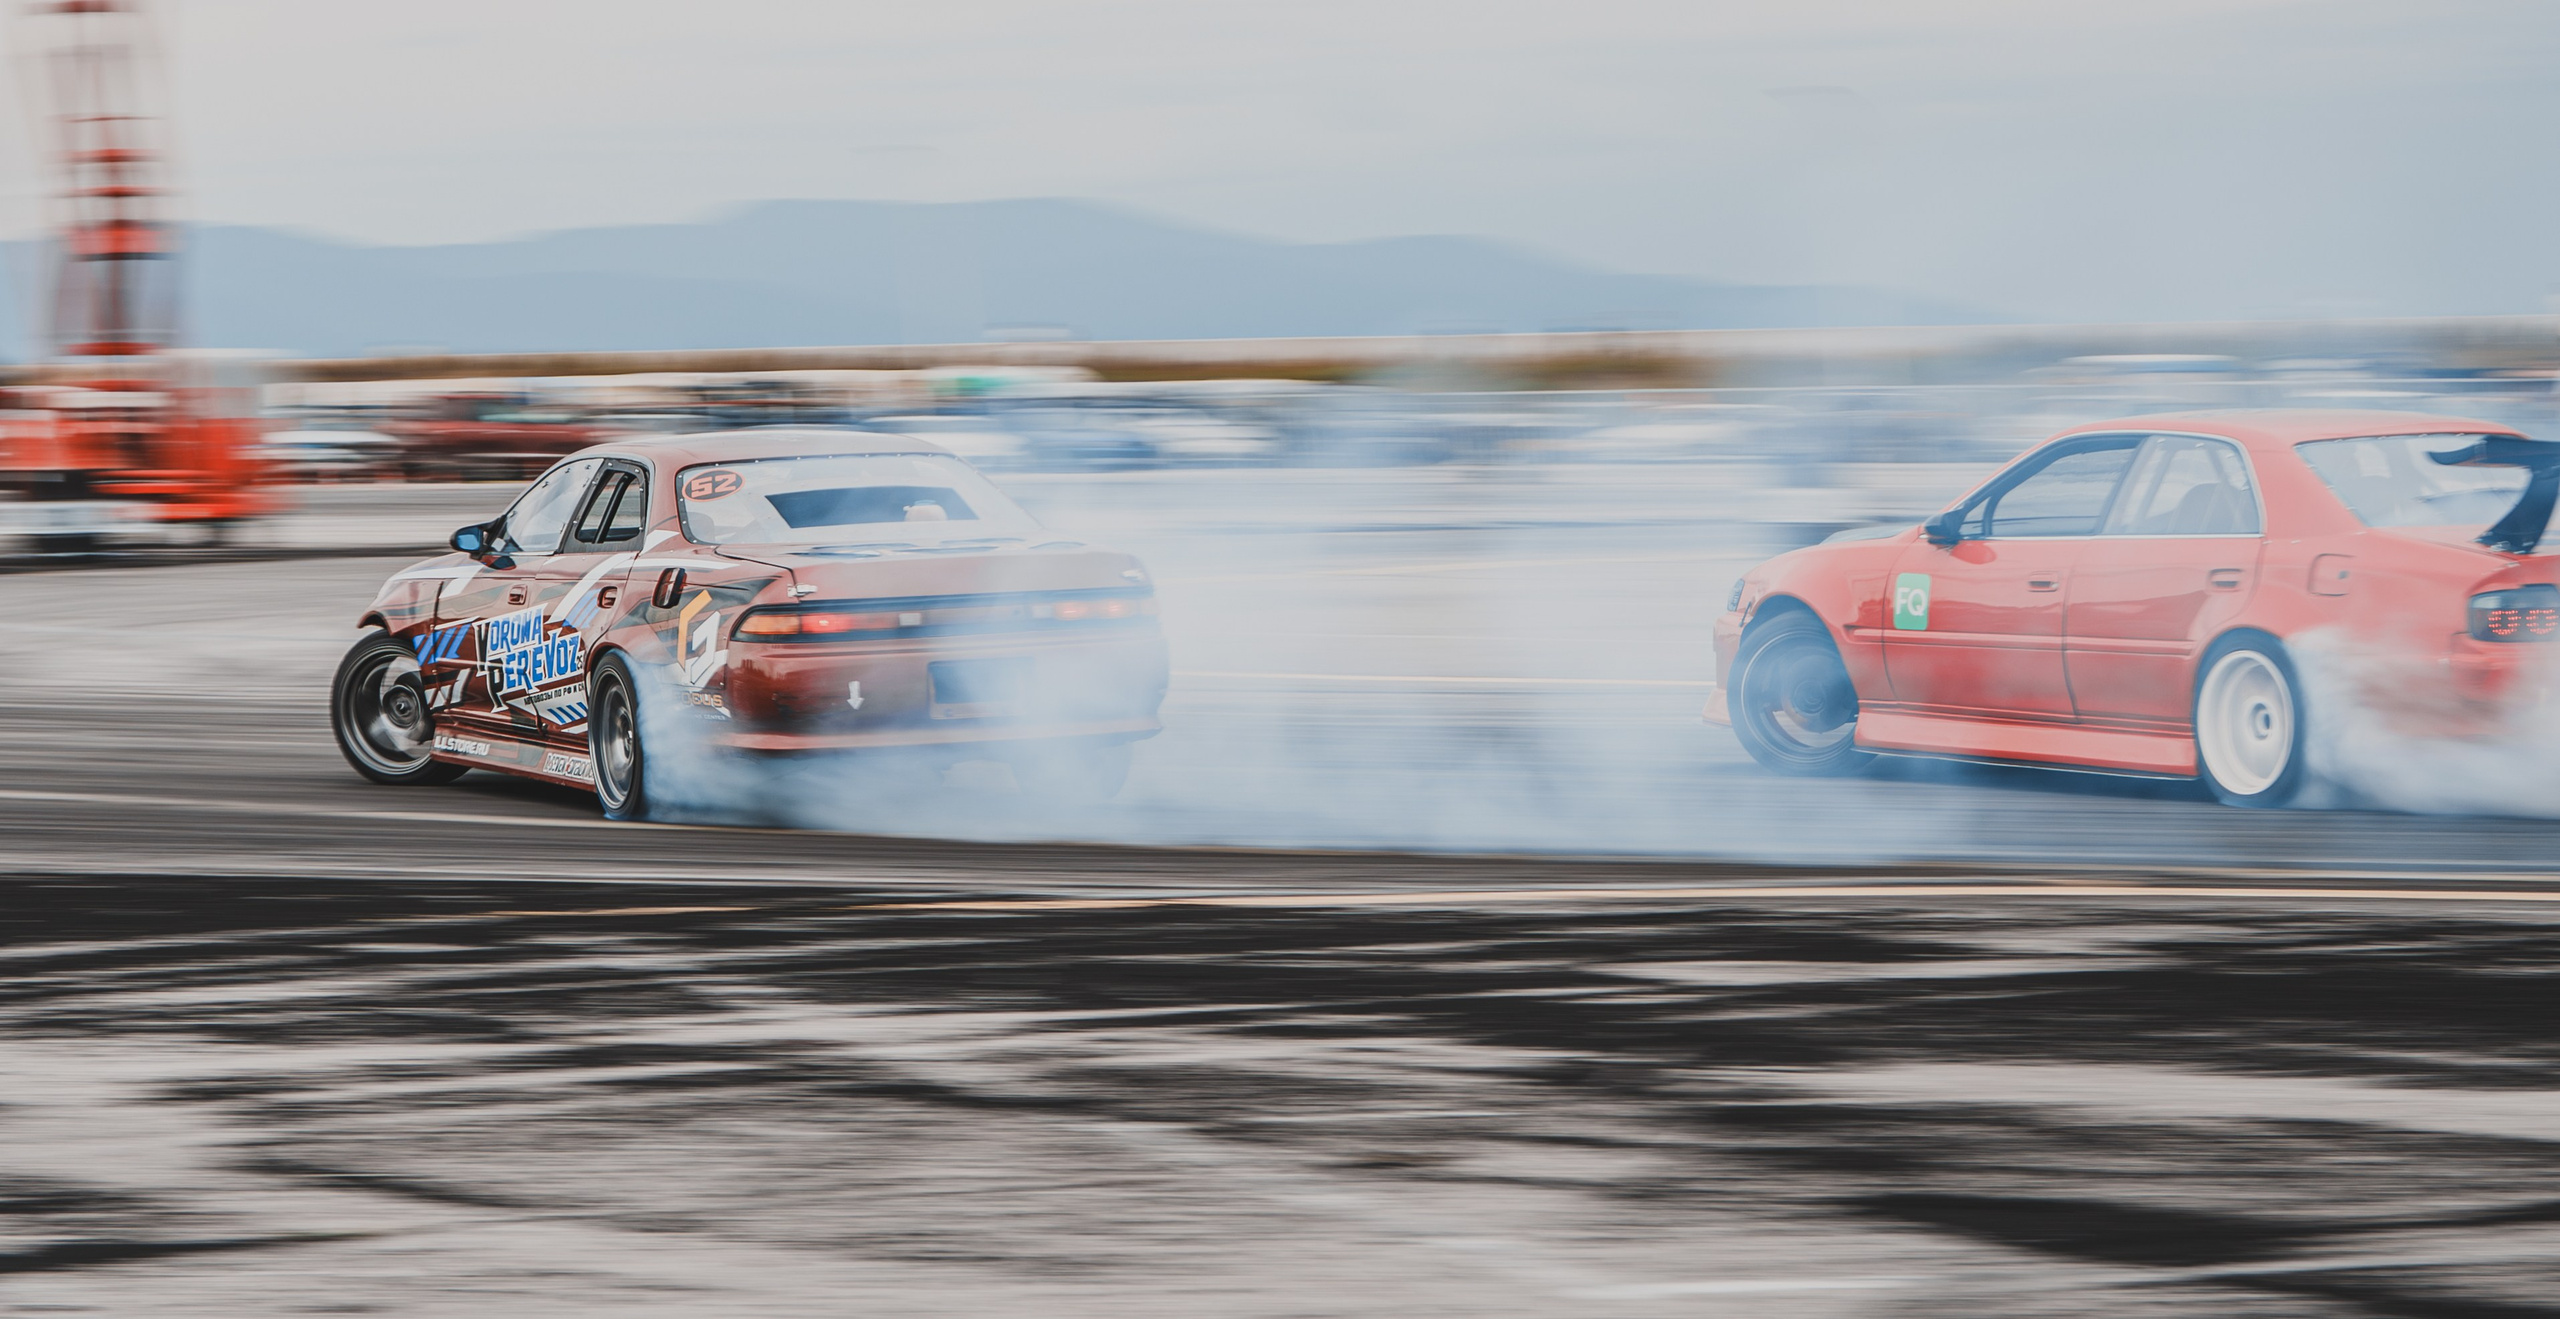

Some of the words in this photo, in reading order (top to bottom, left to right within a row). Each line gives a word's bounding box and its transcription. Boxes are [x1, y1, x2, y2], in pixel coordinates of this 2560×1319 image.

[691, 474, 737, 498] 52
[1896, 587, 1927, 616] FQ
[475, 607, 543, 673] VORONA
[486, 631, 580, 709] PEREVOZ
[563, 686, 572, 696] РФ
